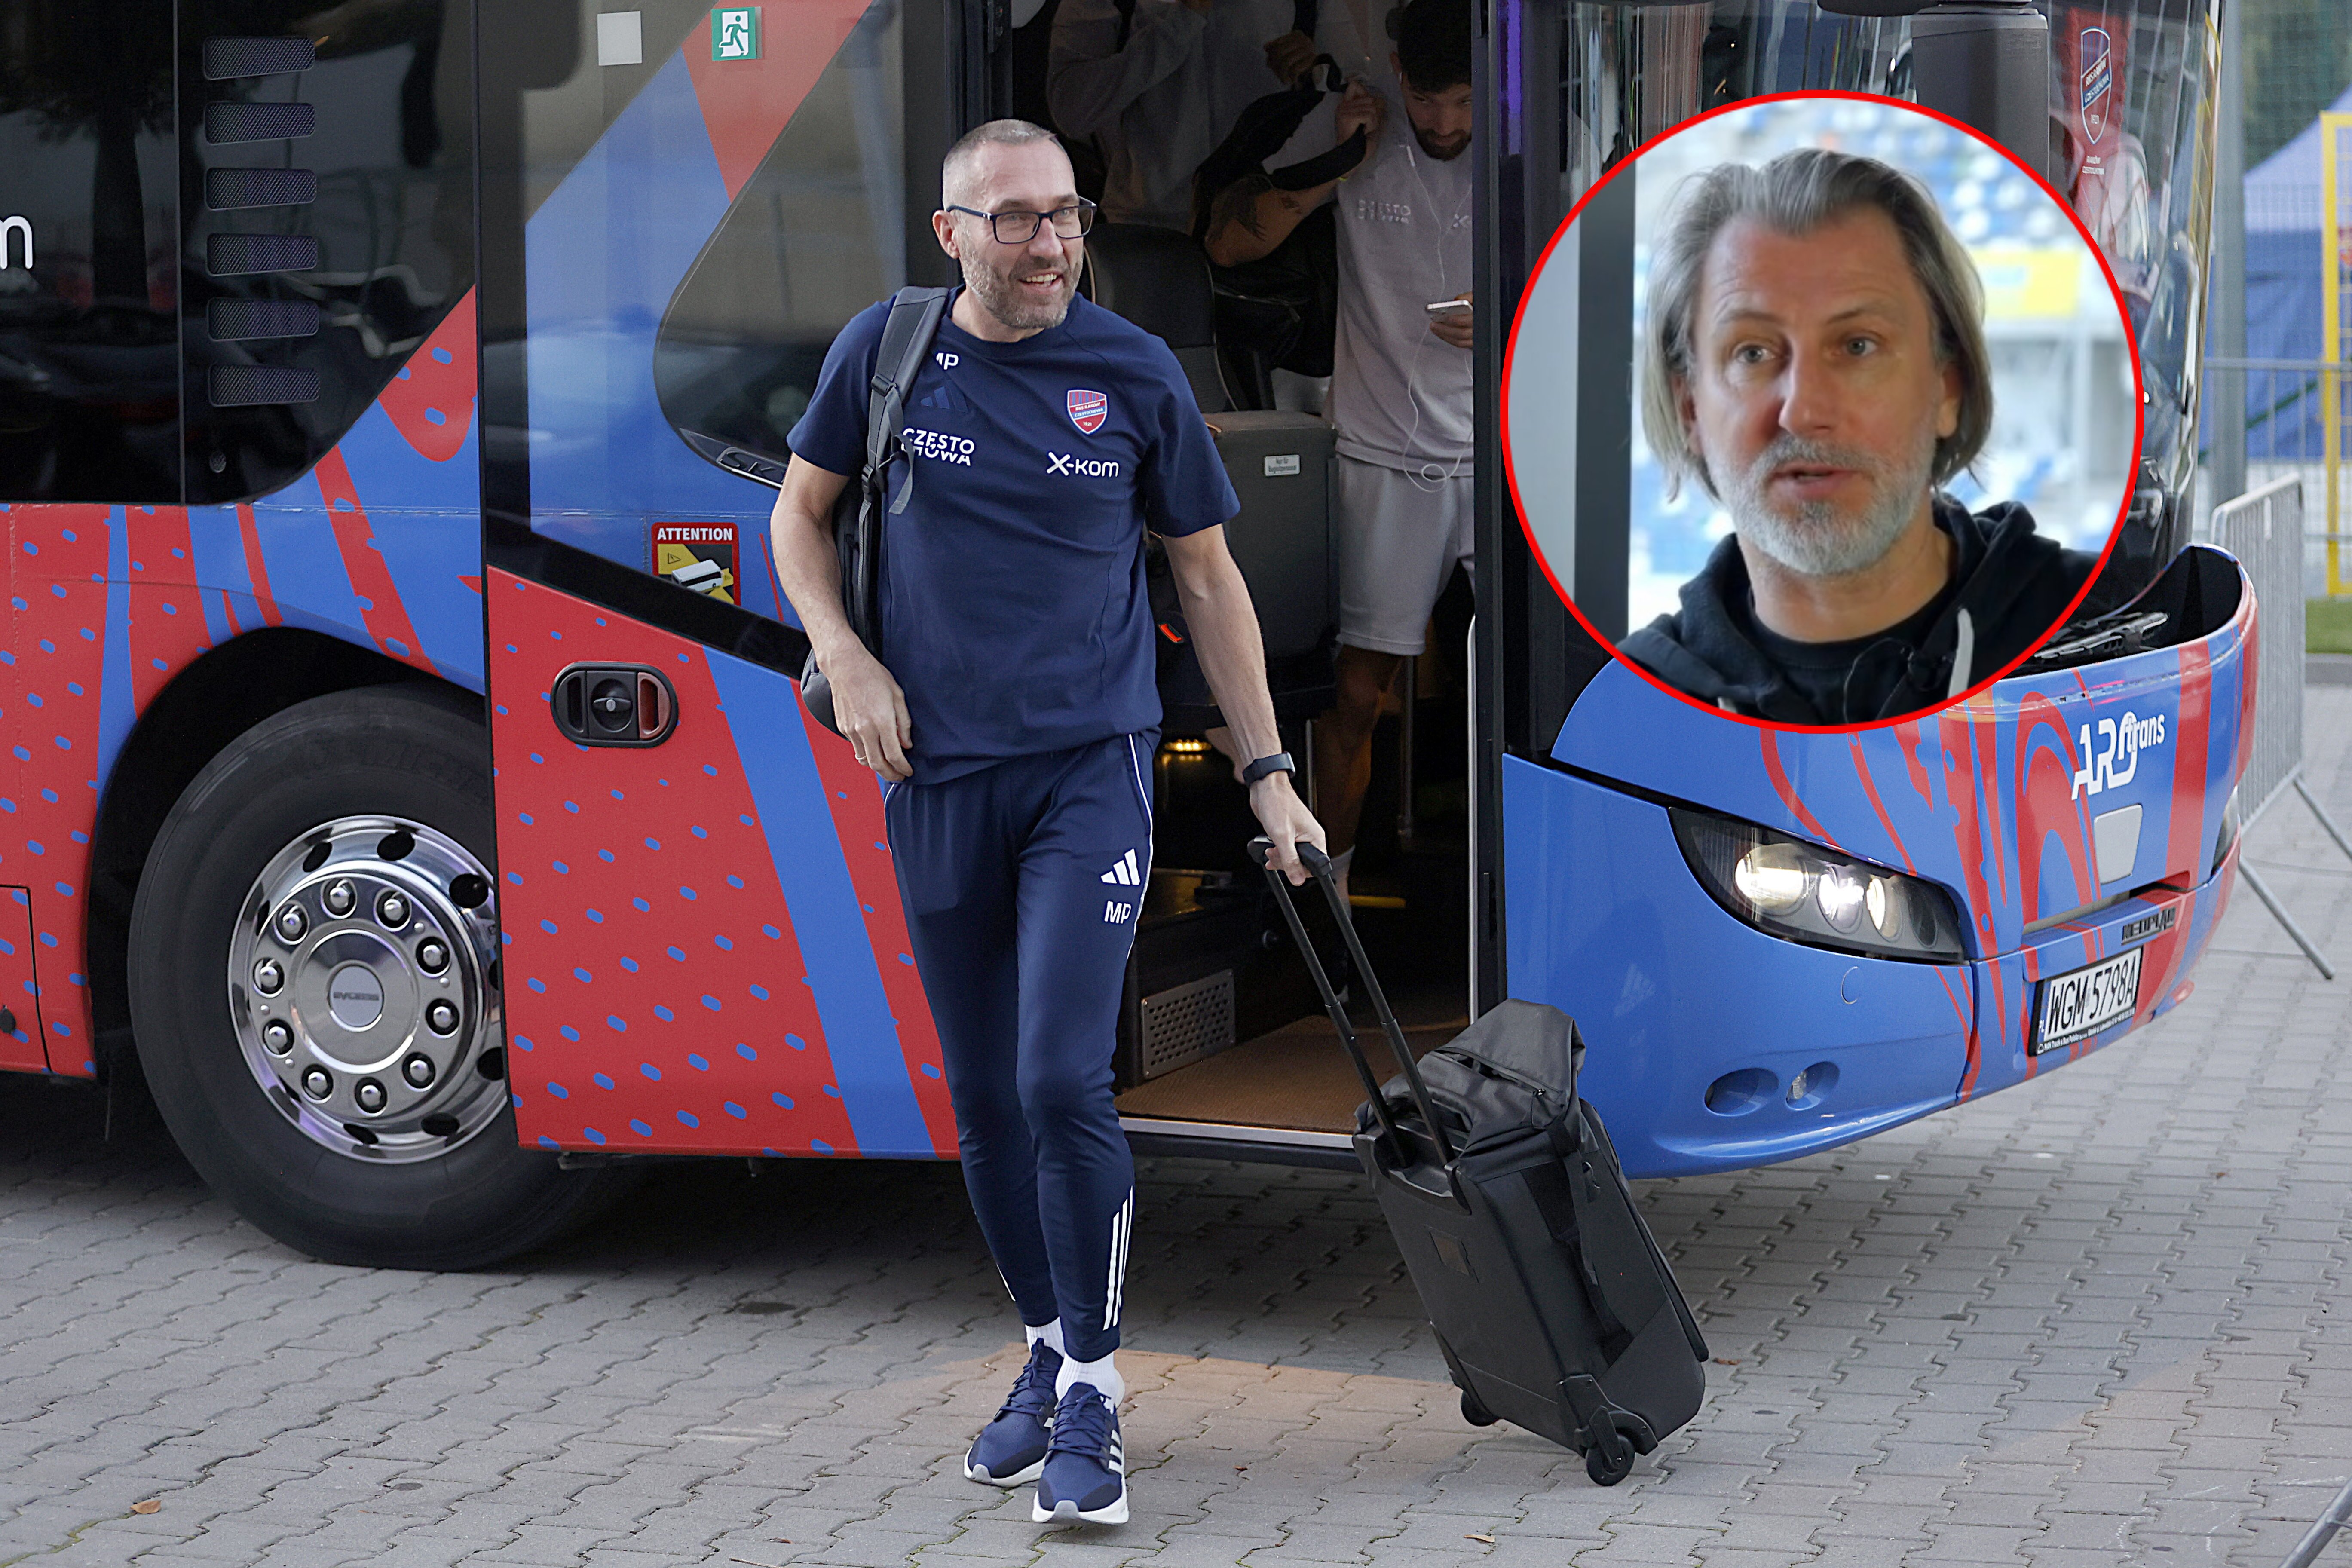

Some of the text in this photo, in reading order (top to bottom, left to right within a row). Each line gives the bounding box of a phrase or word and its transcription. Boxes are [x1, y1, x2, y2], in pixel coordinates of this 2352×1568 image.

[657, 527, 732, 540] ATTENTION
[1104, 900, 1131, 924] MP
[2049, 974, 2089, 1035] WGM
[2089, 955, 2136, 1019] 5798A
[2039, 1020, 2046, 1033] PL
